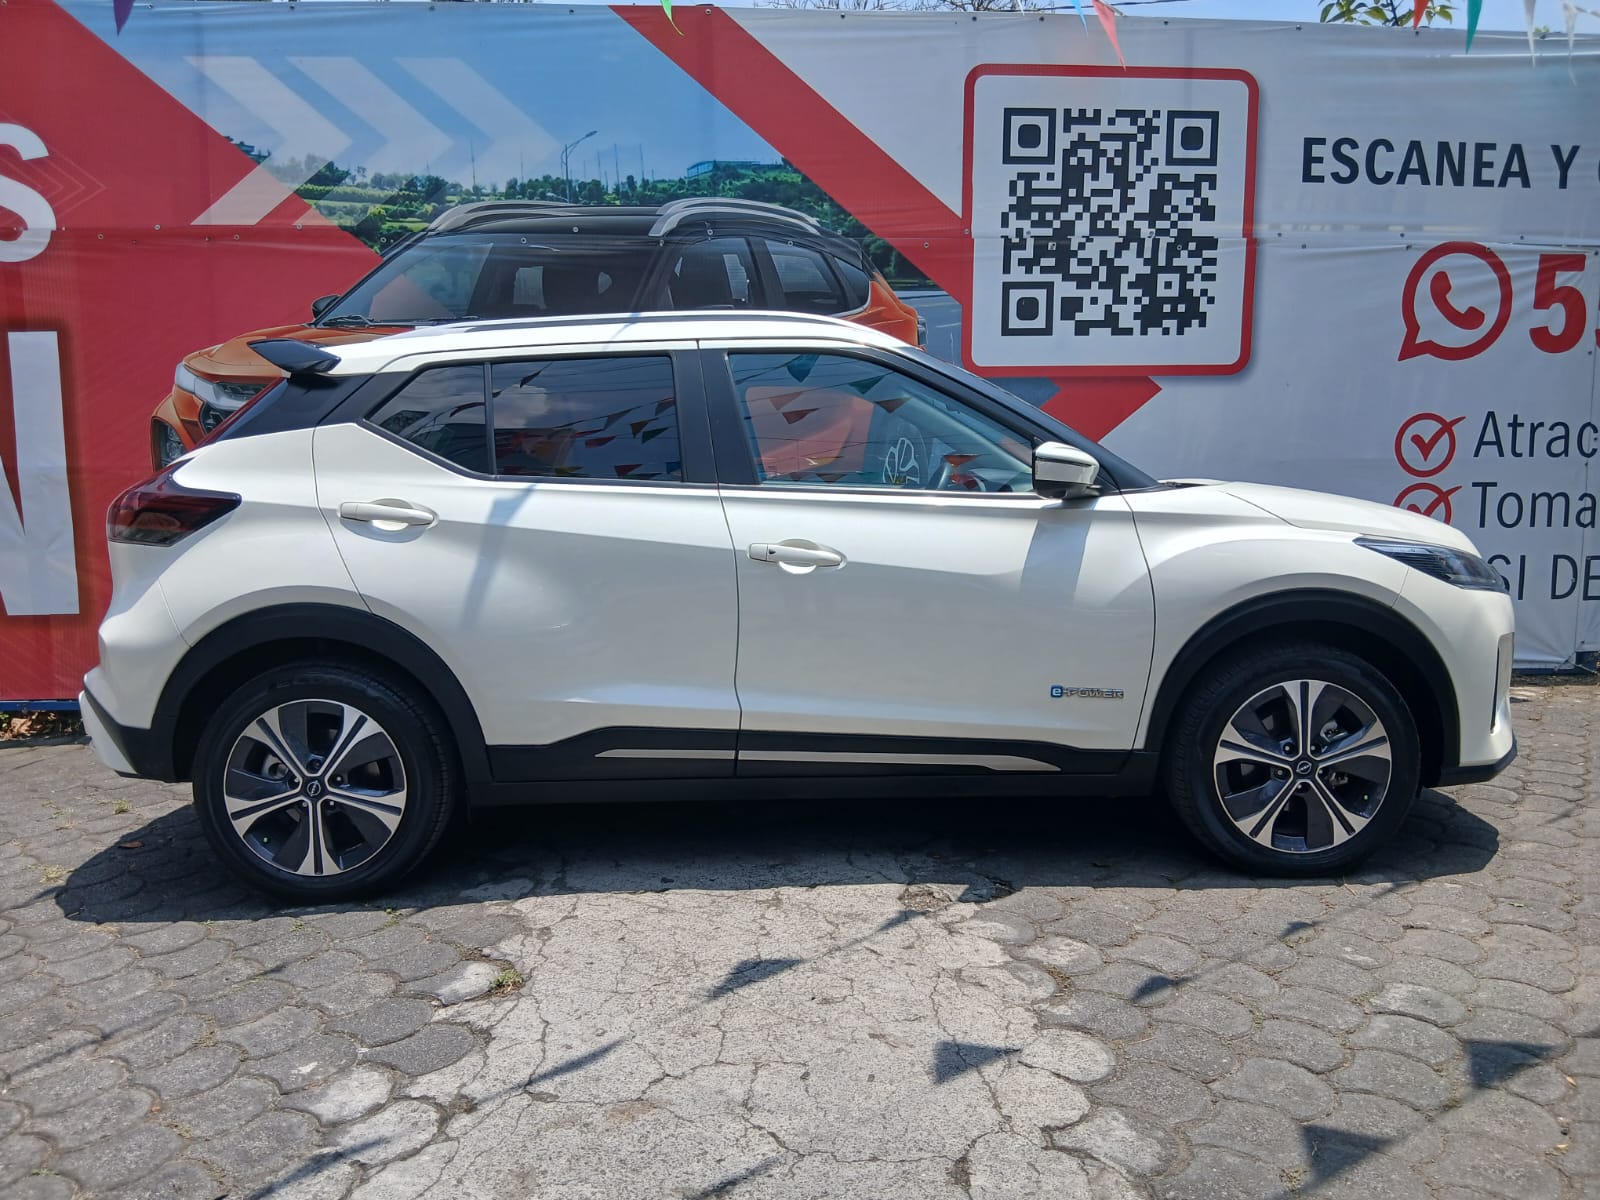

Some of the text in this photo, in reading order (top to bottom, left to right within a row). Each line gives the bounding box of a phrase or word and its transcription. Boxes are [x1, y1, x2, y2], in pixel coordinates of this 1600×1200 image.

[1301, 136, 1532, 189] ESCANEA
[1551, 144, 1581, 190] Y
[1472, 410, 1600, 458] Atrac
[1471, 481, 1598, 529] Toma
[1550, 554, 1600, 601] DE
